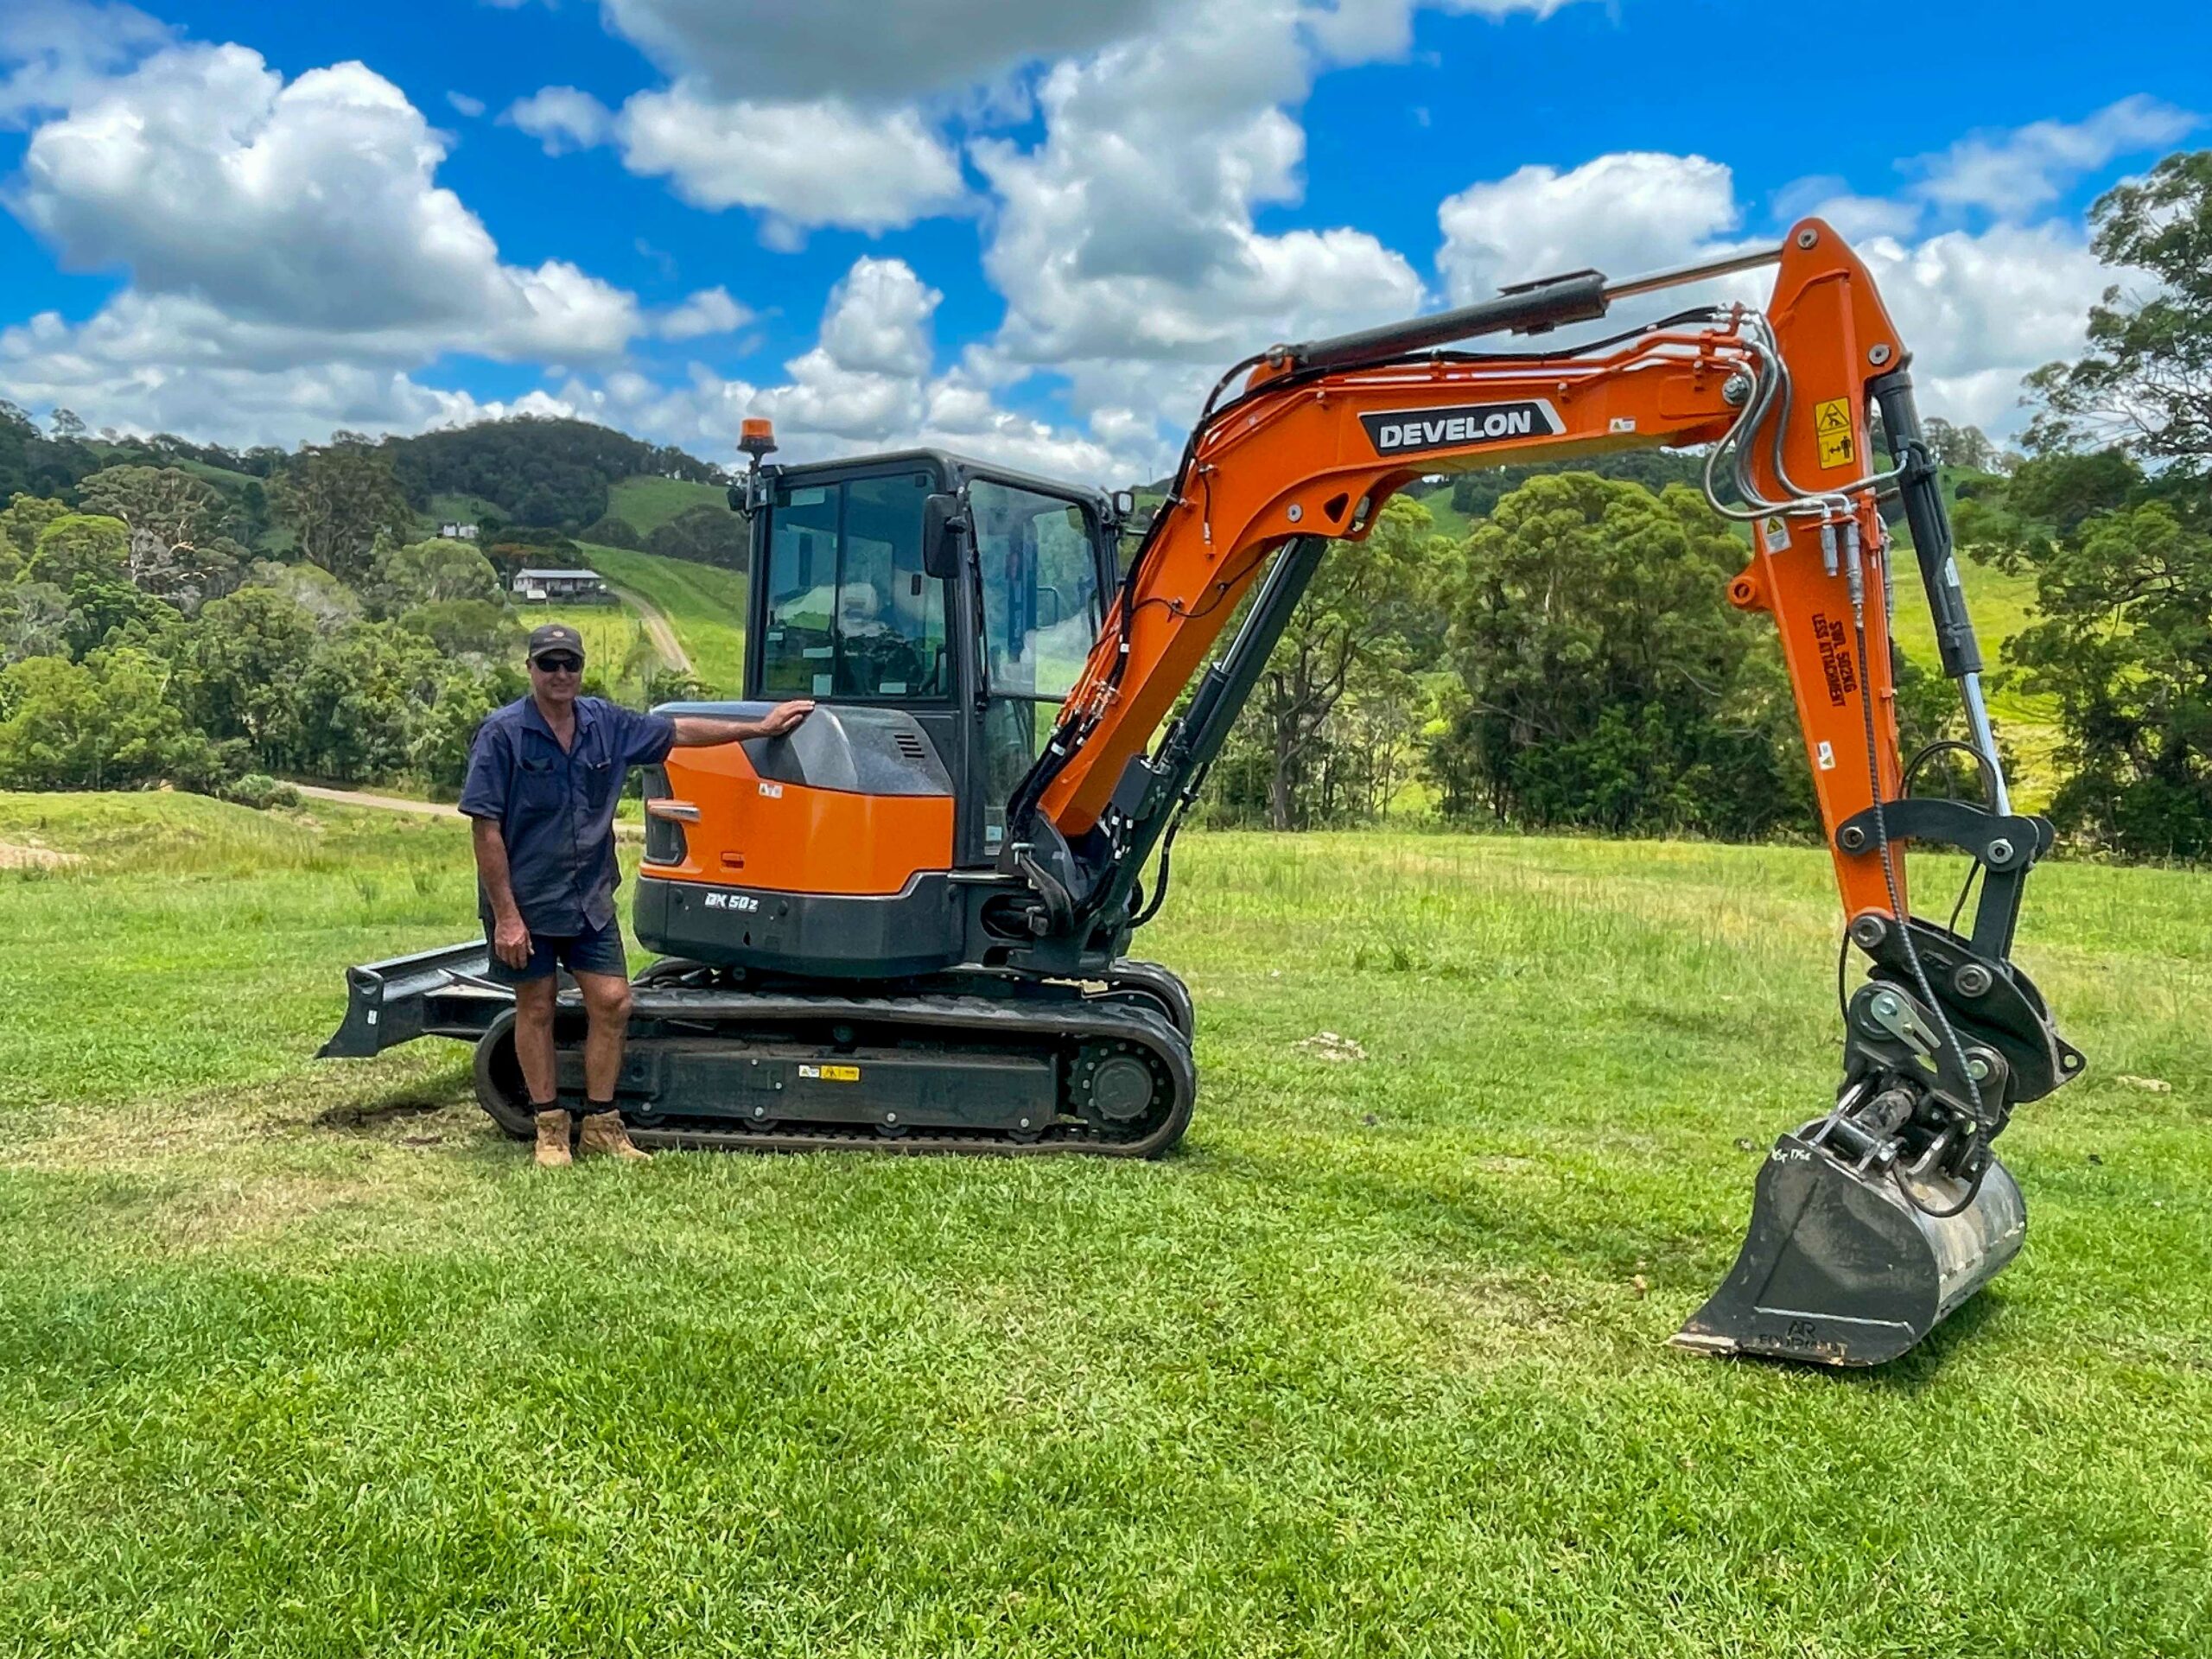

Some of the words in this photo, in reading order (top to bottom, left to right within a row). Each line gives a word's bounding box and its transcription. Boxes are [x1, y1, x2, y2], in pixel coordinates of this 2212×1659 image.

[1380, 410, 1530, 448] DEVELON
[1812, 613, 1829, 639] LESS
[1829, 620, 1846, 648] SWL
[1819, 642, 1846, 707] ATTACHMENT
[1787, 1319, 1816, 1339] AR
